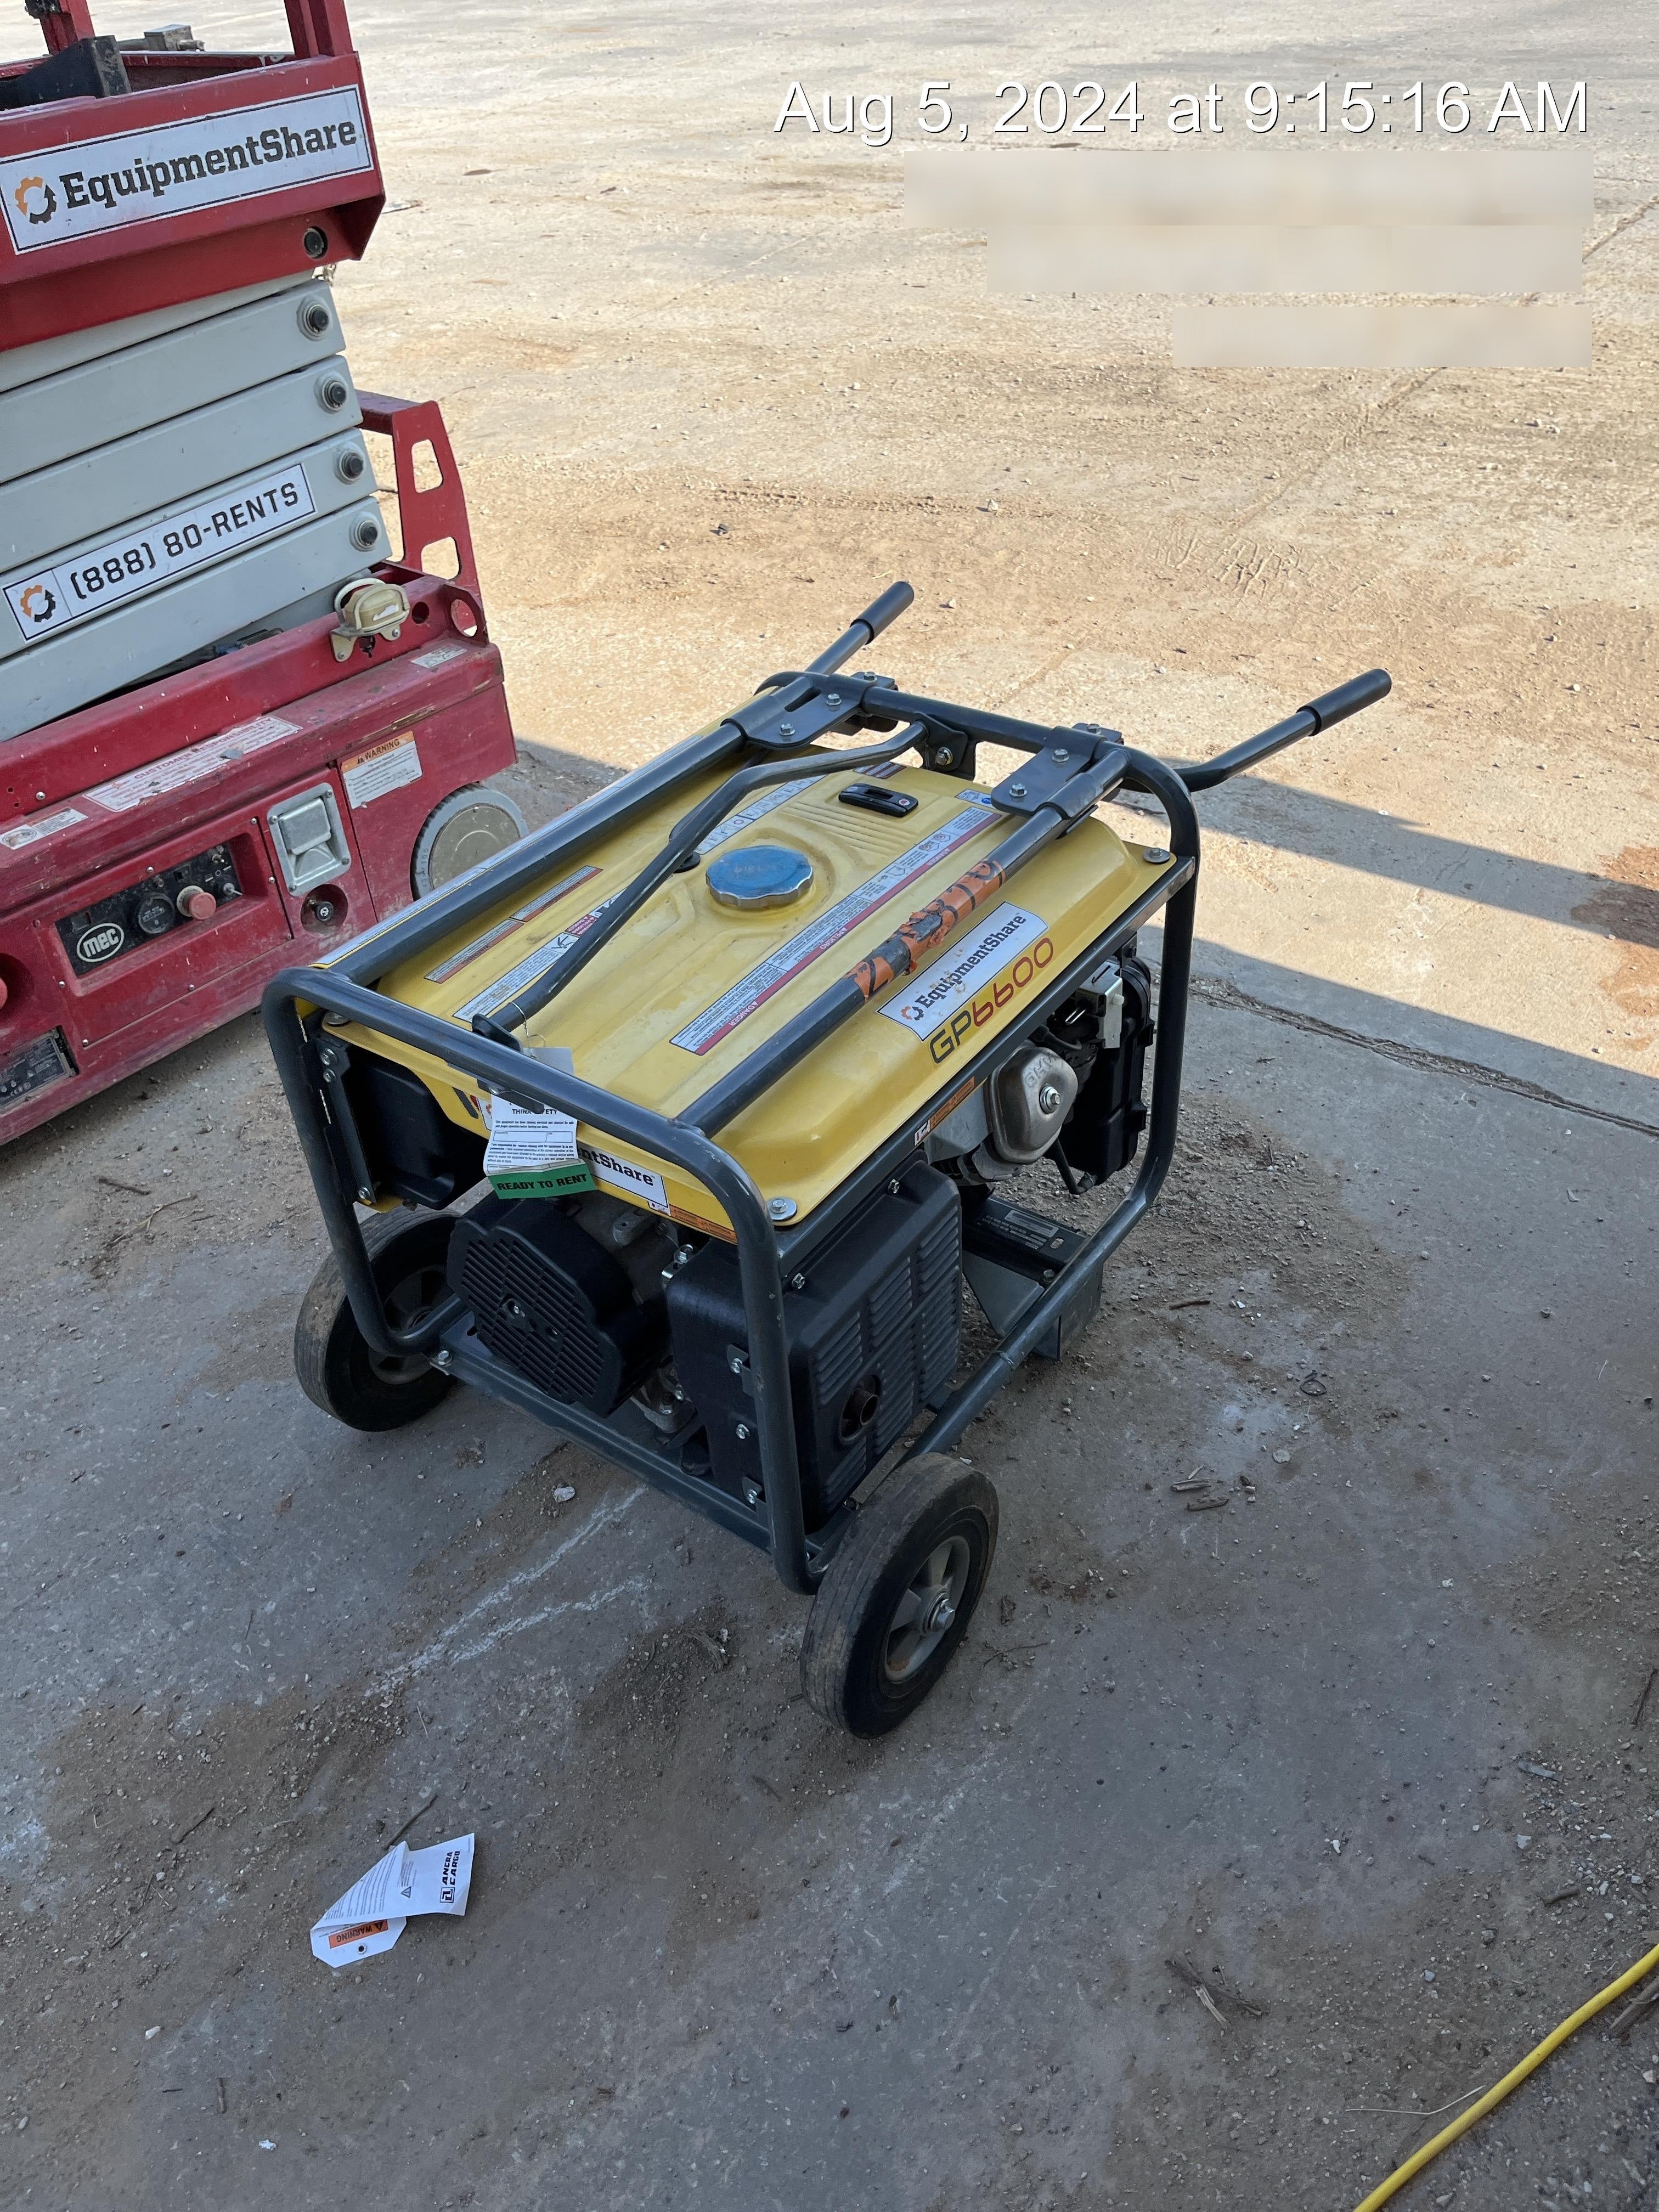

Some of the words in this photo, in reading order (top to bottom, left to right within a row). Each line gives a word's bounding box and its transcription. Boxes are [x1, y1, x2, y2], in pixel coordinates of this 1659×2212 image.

[59, 121, 357, 208] EquipmentShare
[70, 542, 157, 600] (888)
[163, 482, 299, 558] 80-RENTS
[134, 753, 192, 780] CUSTOMER
[364, 738, 400, 760] WARNING
[915, 914, 1026, 1009] EquipmentShare
[729, 1003, 756, 1026] DANGER
[929, 936, 1054, 1065] GP6600
[496, 1181, 535, 1191] READY
[537, 1180, 554, 1189] TO
[555, 1173, 588, 1187] RENT
[578, 1147, 654, 1186] ntShare
[441, 1850, 453, 1886] ANCRA
[449, 1850, 461, 1886] CARGO
[336, 1924, 373, 1943] WARNING
